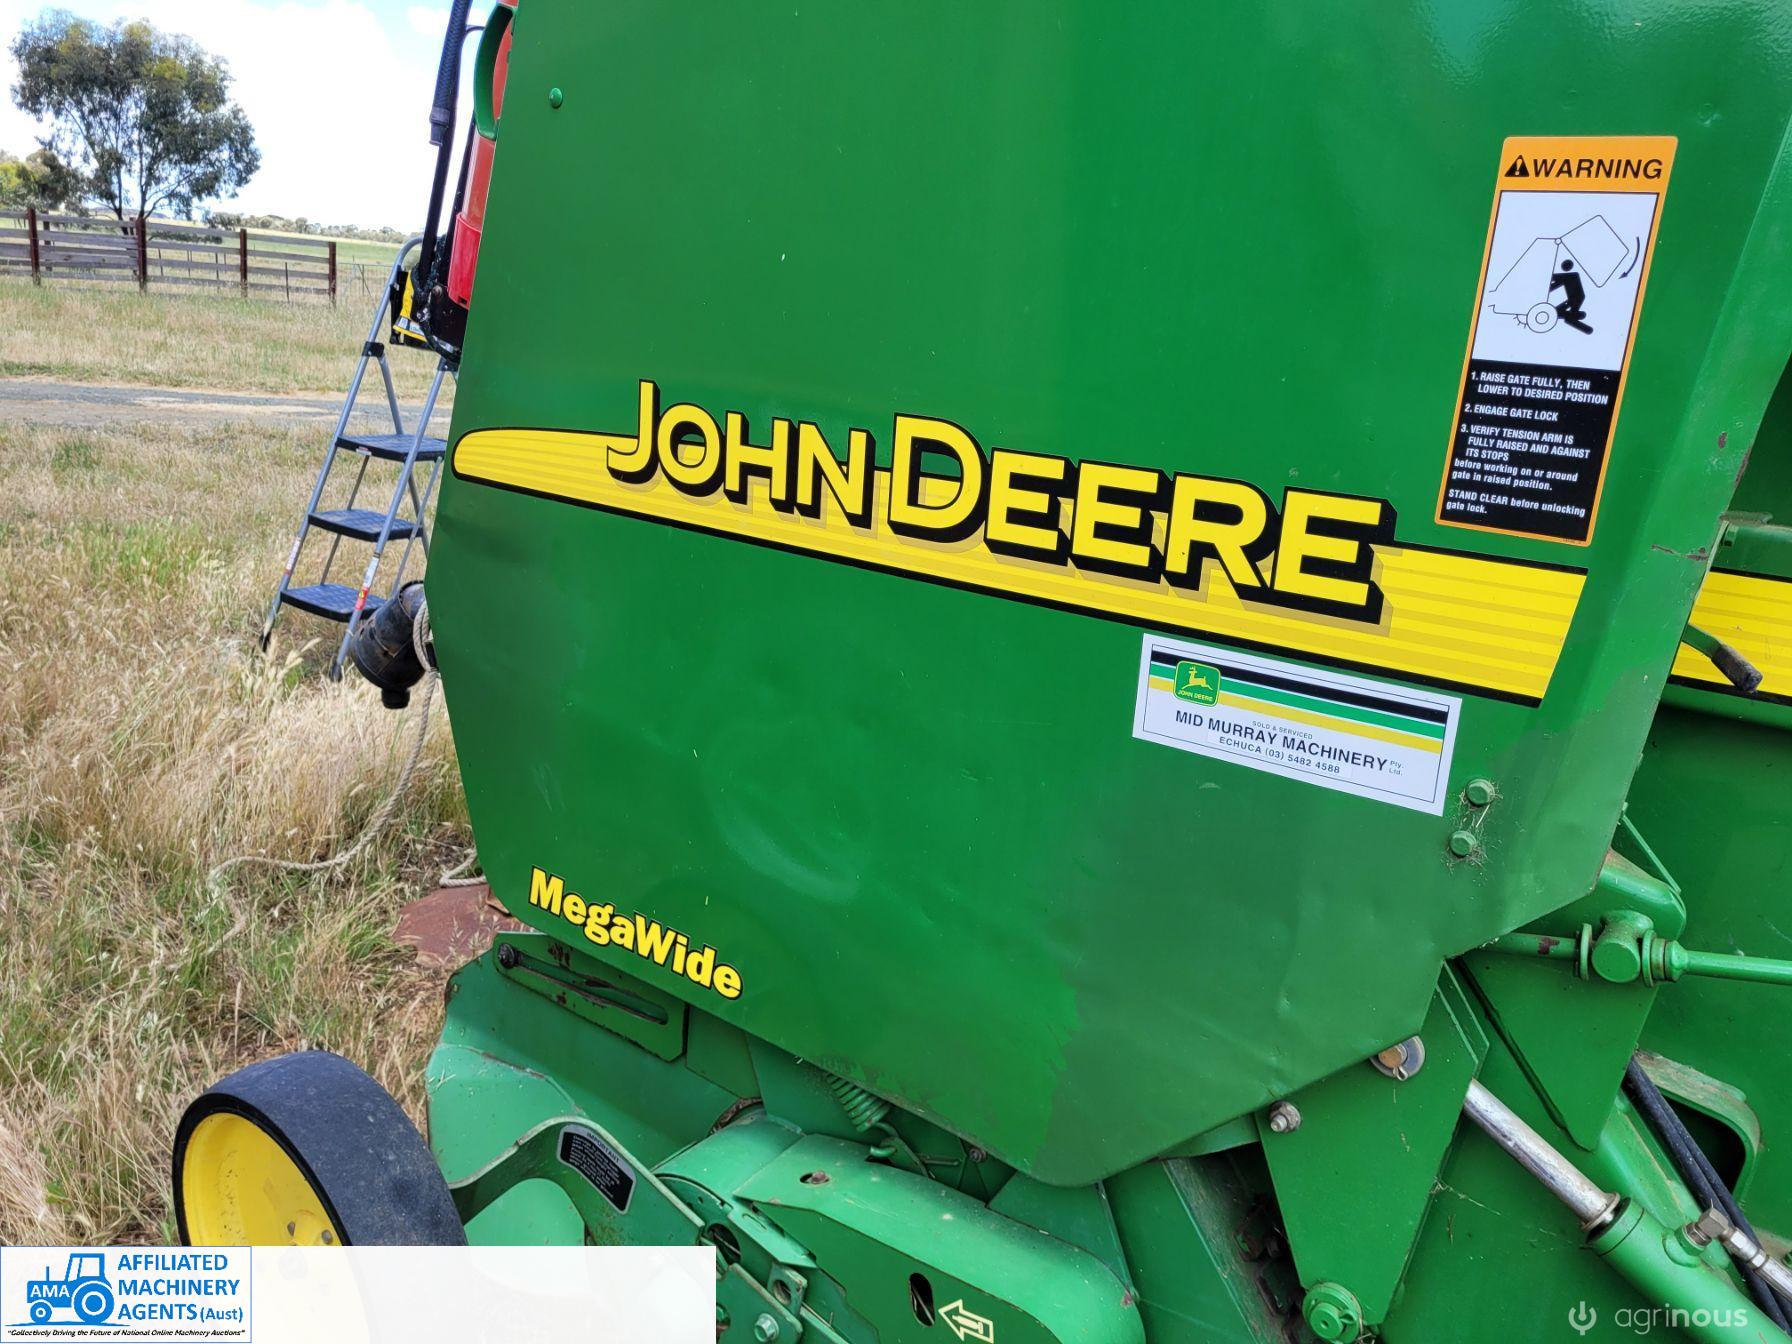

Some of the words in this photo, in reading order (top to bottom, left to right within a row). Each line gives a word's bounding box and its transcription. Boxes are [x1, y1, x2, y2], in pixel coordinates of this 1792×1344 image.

[1533, 158, 1663, 180] WARNING
[1471, 371, 1479, 381] 1.
[1480, 371, 1506, 383] RAISE
[1507, 374, 1531, 385] GATE
[1566, 379, 1591, 391] THEN
[1477, 384, 1509, 396] LOWER
[1510, 386, 1523, 397] TO
[1524, 387, 1563, 400] DESIRED
[1564, 391, 1609, 405] POSITION
[1464, 403, 1473, 413] 2.
[1473, 404, 1509, 417] ENGAGE
[1509, 408, 1533, 419] GATE
[1534, 410, 1559, 422] LOCK
[1460, 423, 1469, 433] 3.
[1470, 424, 1501, 437] VERIFY
[1502, 427, 1541, 441] TENSION
[1541, 432, 1563, 444] ARM
[1564, 435, 1574, 445] IS
[1465, 447, 1480, 458] ITS
[1480, 449, 1510, 462] STOPS
[1467, 436, 1495, 448] FULLY
[1496, 439, 1529, 452] RAISED
[1529, 443, 1549, 454] AND
[1550, 445, 1591, 459] AGAINST
[1452, 470, 1471, 480] gate
[1472, 472, 1482, 482] in
[1483, 474, 1512, 485] raised
[1512, 478, 1553, 491] position.
[1454, 458, 1482, 470] before
[1483, 463, 1518, 476] working
[1520, 468, 1532, 477] on
[1534, 469, 1545, 478] or
[1545, 470, 1579, 482] around
[607, 379, 877, 529] JOHN
[888, 412, 1398, 625] DEERE
[1446, 501, 1465, 511] gate
[1467, 502, 1488, 514] lock.
[1448, 488, 1478, 501] STAND
[1479, 493, 1509, 506] CLEAR
[1510, 497, 1540, 510] before
[1541, 503, 1586, 518] unlocking
[1178, 690, 1193, 698] JOHN
[1194, 693, 1213, 702] DEERE
[1175, 710, 1204, 727] MID
[1208, 717, 1278, 745] MURRAY
[1282, 735, 1388, 771] MACHINERY
[1252, 720, 1271, 730] SOLD
[1279, 726, 1313, 740] SERVICED
[1219, 736, 1262, 754] ECHUCA
[1265, 747, 1284, 761] (03)
[1287, 754, 1312, 767] 5482
[1315, 761, 1340, 774] 4588
[1388, 767, 1403, 777] Ltd.
[528, 864, 744, 1001] MegaWide
